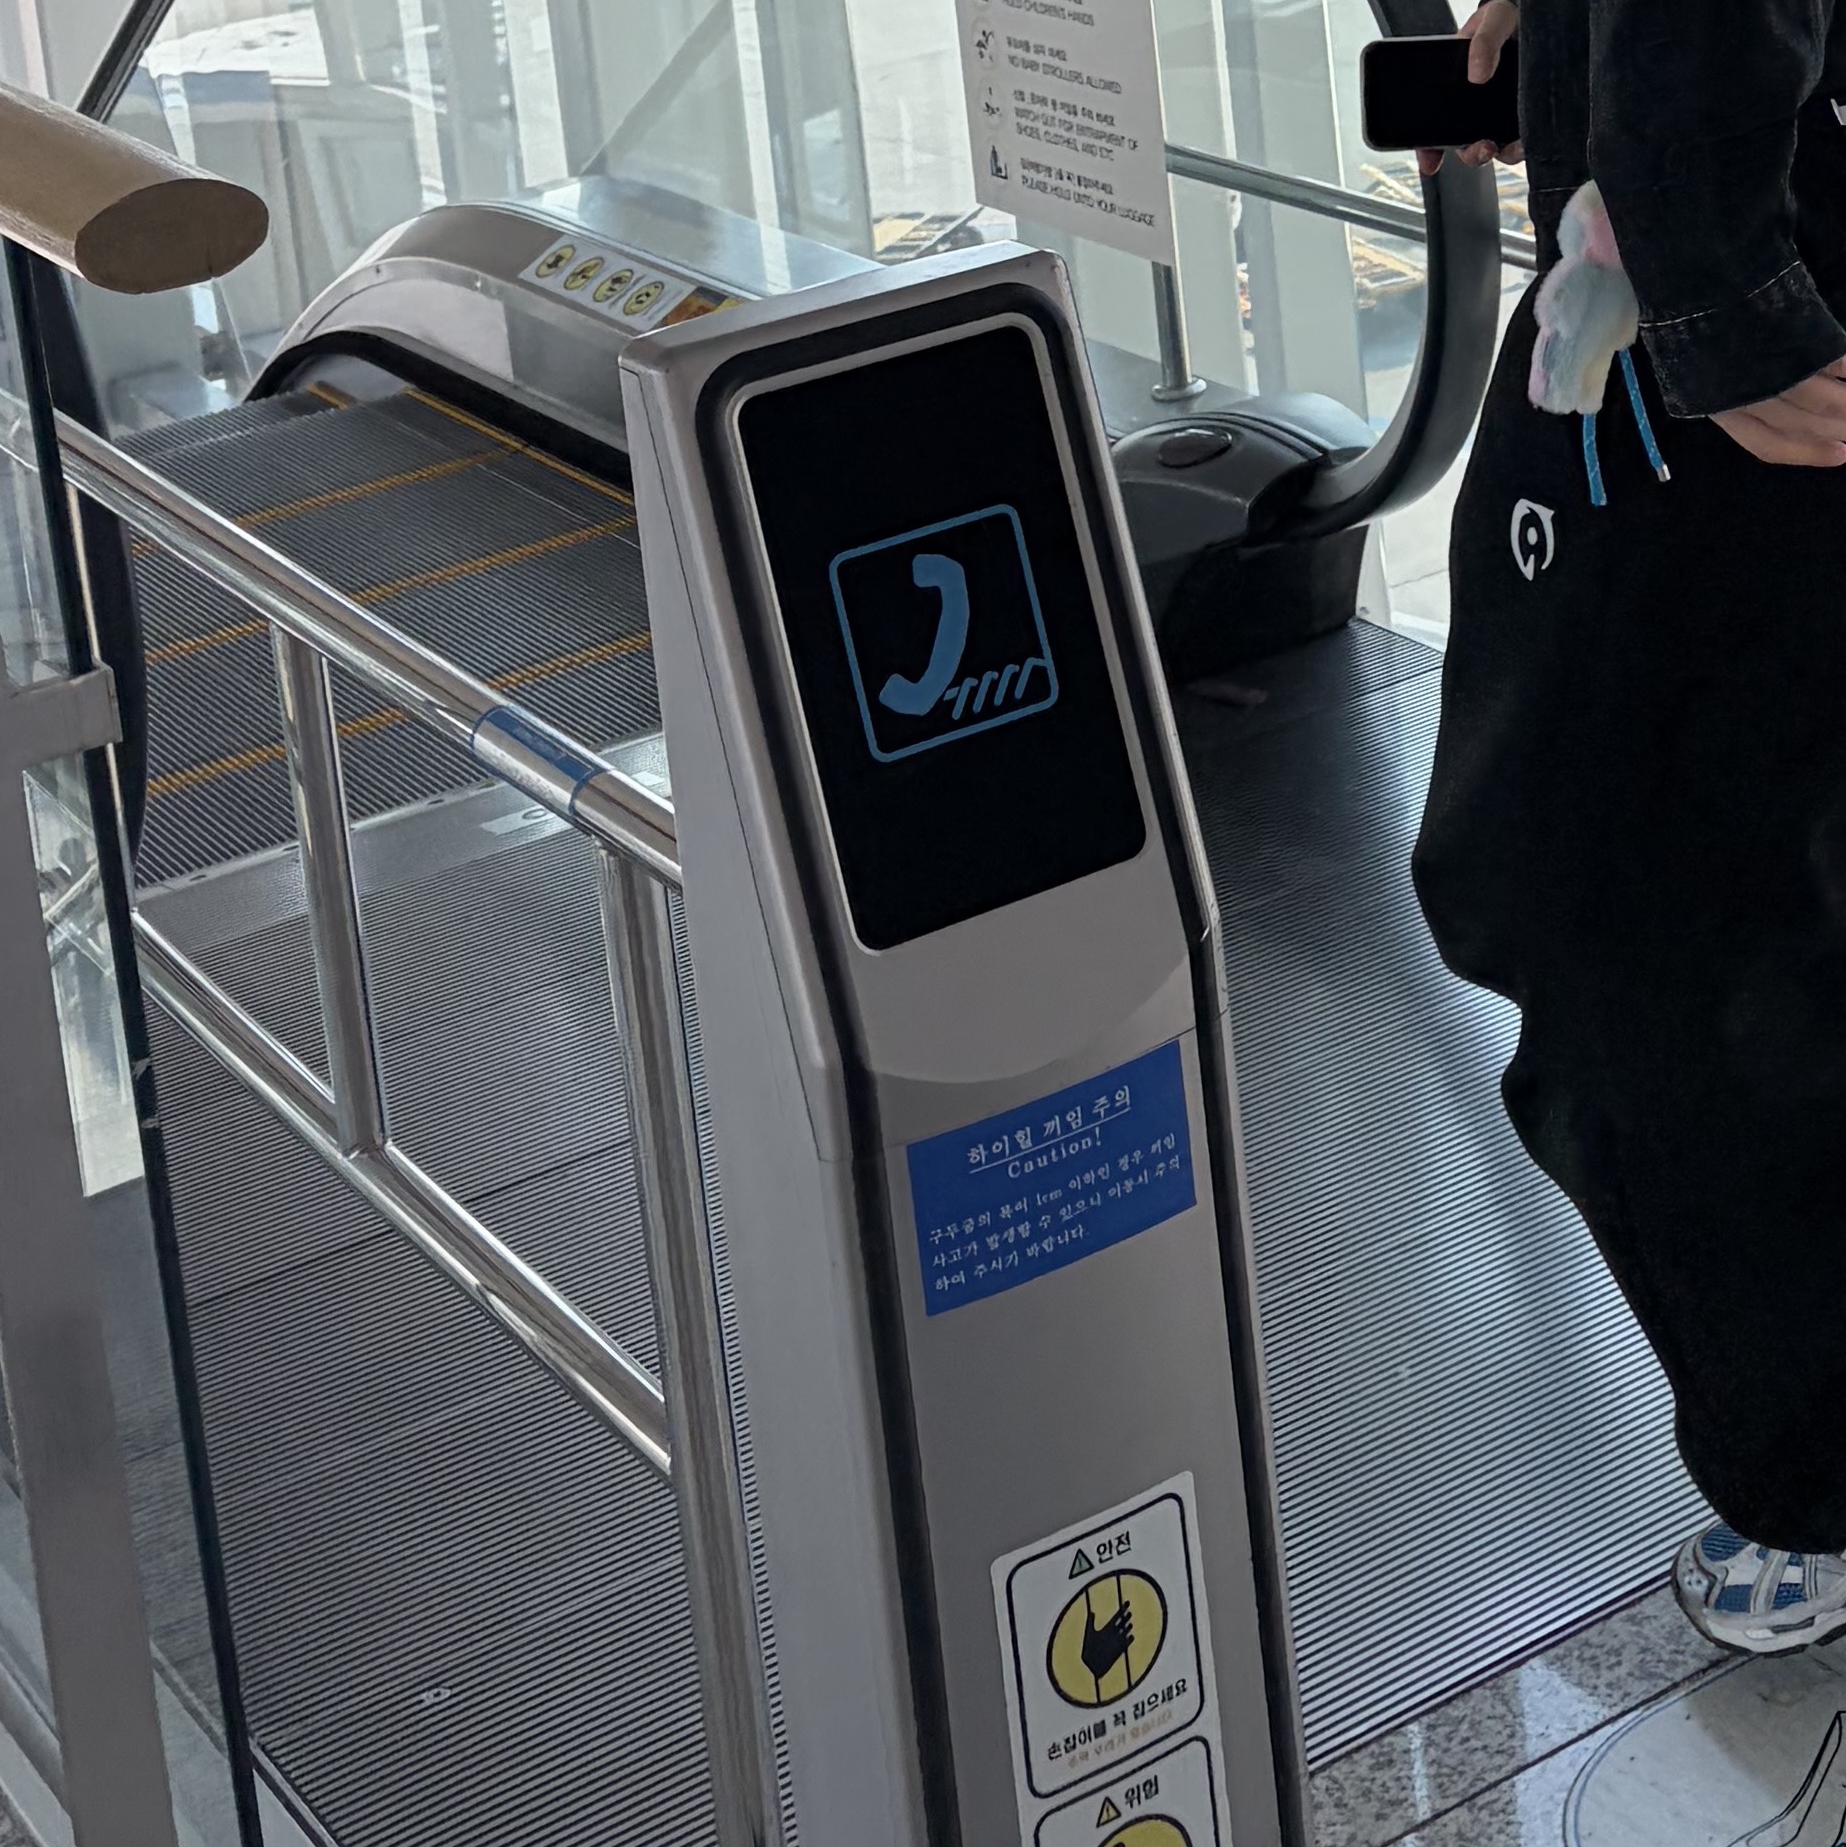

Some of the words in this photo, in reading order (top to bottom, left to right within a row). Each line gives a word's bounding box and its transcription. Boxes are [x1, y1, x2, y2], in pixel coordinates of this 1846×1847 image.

[967, 1126, 1032, 1166] 하이힐
[1042, 1106, 1082, 1138] 끼임
[1092, 1085, 1131, 1119] 주의
[1008, 1126, 1102, 1178] Caution!
[1068, 1163, 1110, 1190] 이하인
[932, 1241, 978, 1267] 사고가
[935, 1270, 966, 1291] 하여
[974, 1250, 1019, 1279] 주시기
[1095, 1531, 1132, 1564] 안전
[1124, 1774, 1159, 1809] 위험
